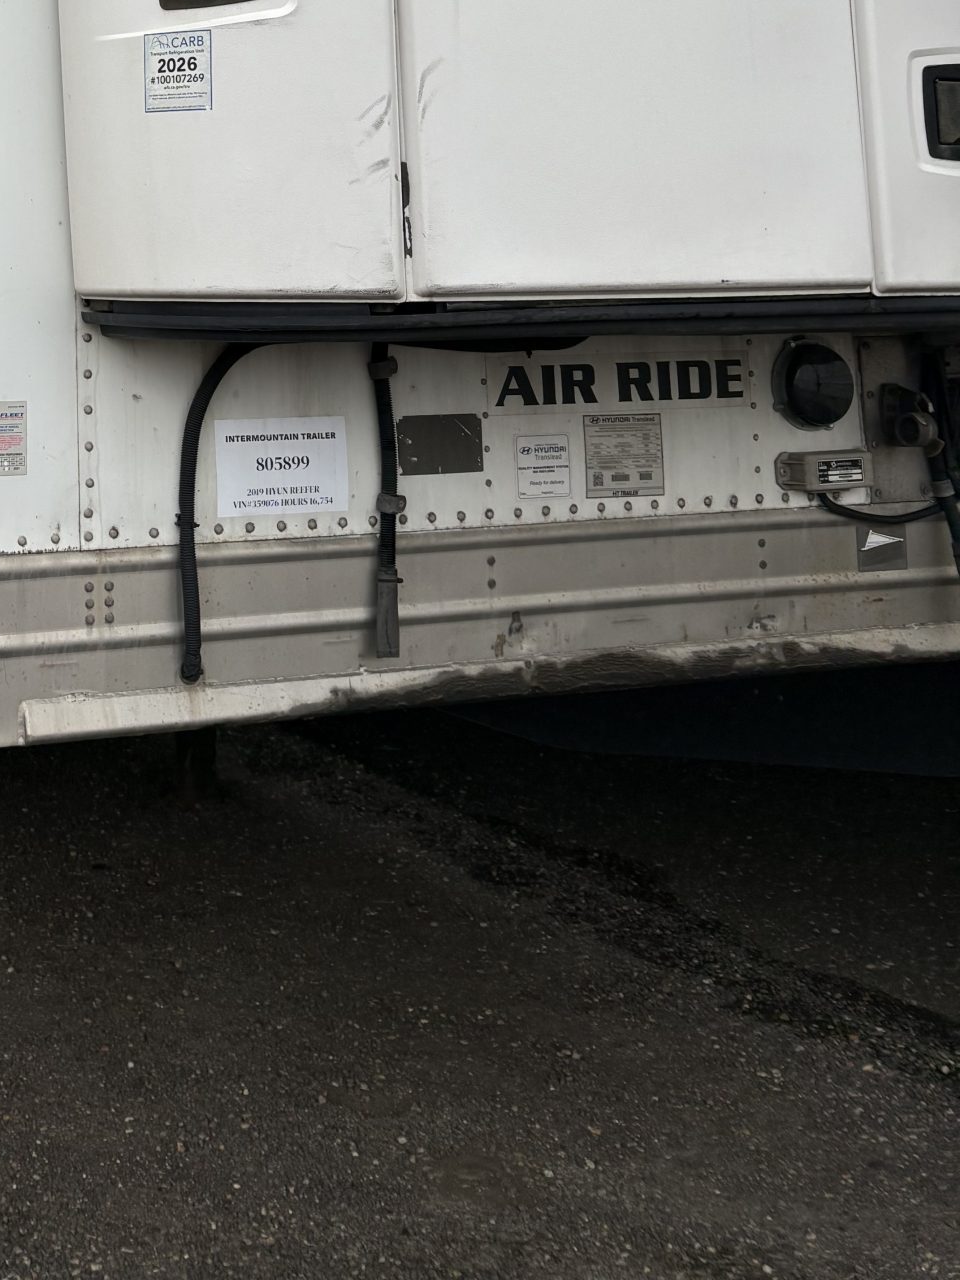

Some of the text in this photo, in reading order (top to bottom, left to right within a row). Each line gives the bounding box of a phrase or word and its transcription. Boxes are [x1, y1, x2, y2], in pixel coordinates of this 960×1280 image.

[171, 36, 204, 48] CARB
[157, 56, 198, 73] 2026
[150, 73, 205, 85] #100107269
[495, 359, 744, 406] AIR RIDE
[602, 416, 630, 424] HYUNDAI
[225, 432, 336, 443] INTERMOUNTAIN TRAILER
[256, 455, 310, 471] 805899
[246, 485, 320, 497] 2019 HYUN REEFER
[233, 499, 279, 509] VIN#359076
[280, 498, 308, 507] HOURS
